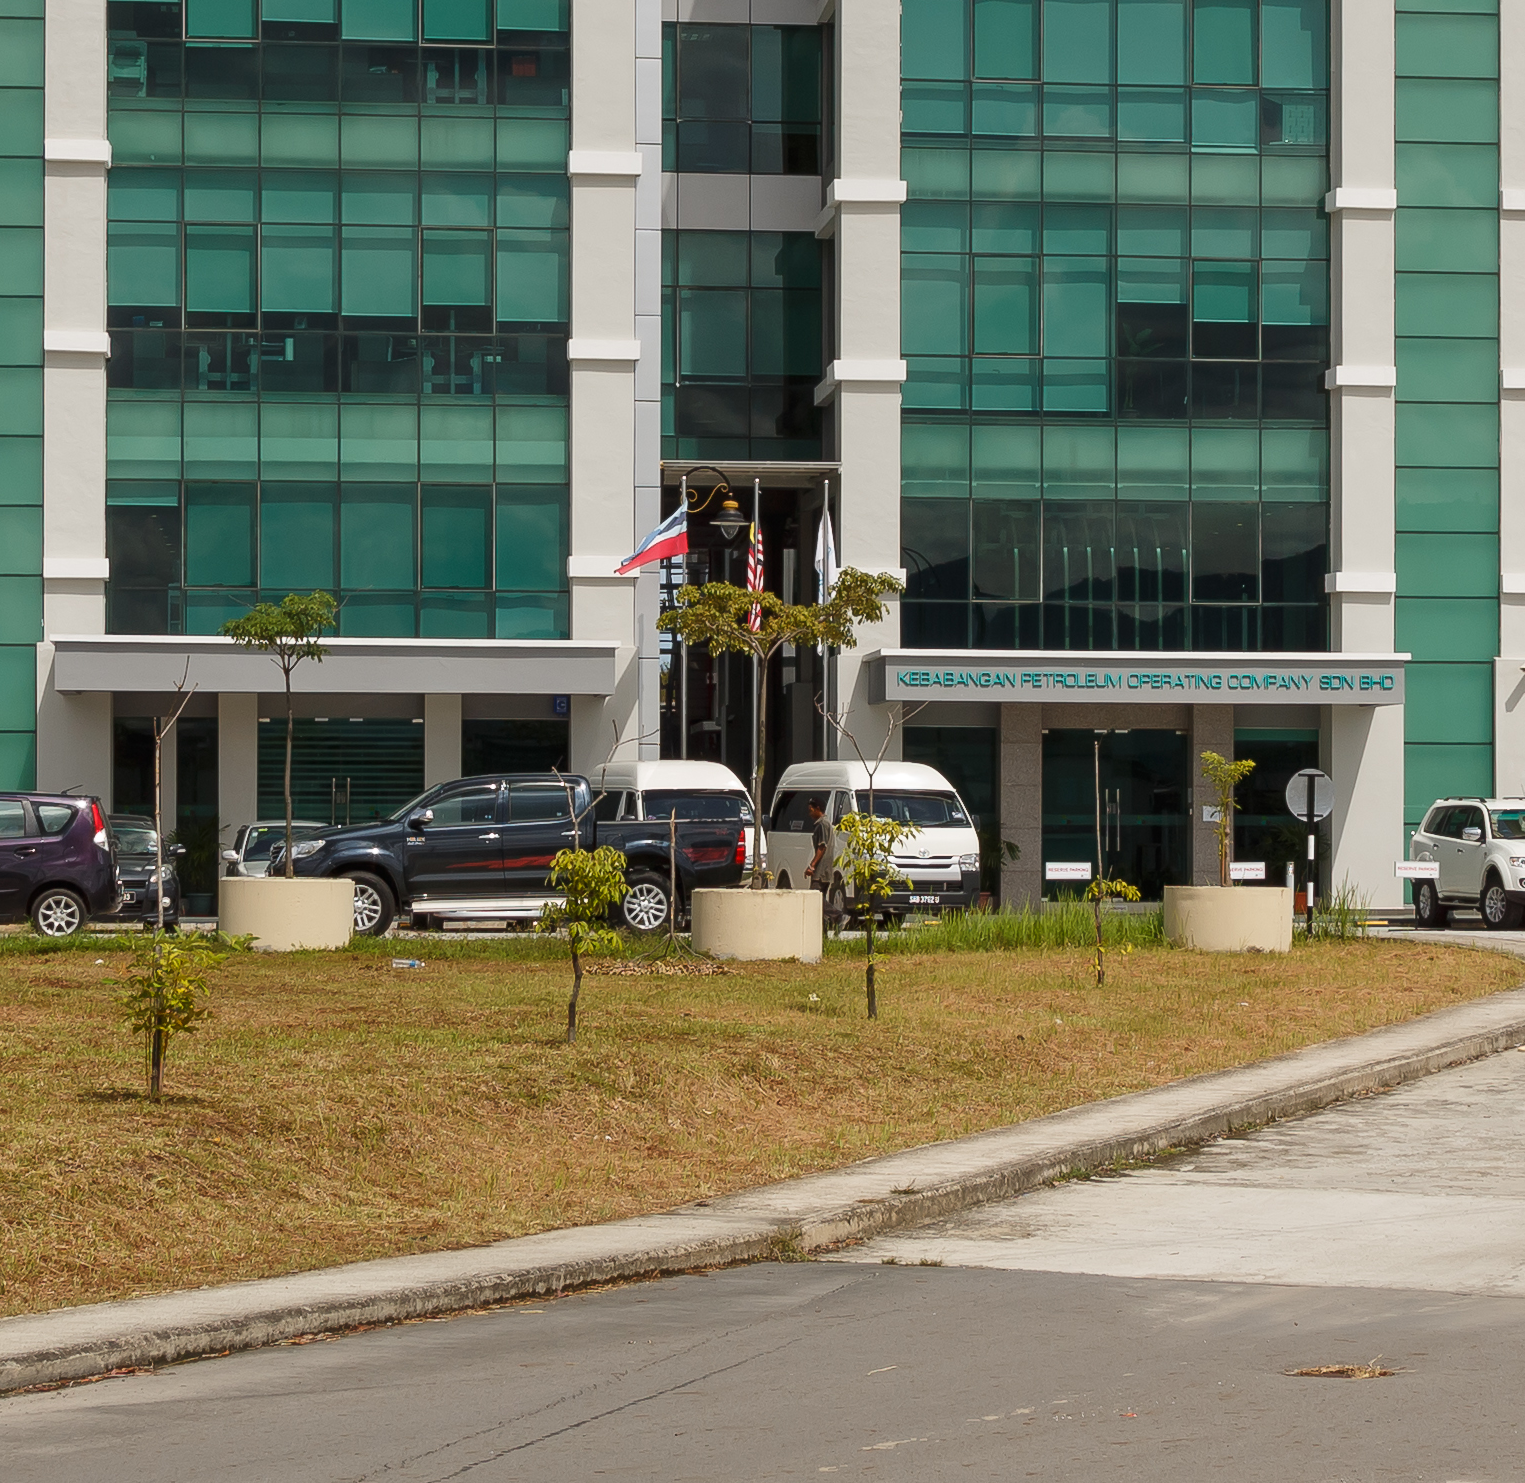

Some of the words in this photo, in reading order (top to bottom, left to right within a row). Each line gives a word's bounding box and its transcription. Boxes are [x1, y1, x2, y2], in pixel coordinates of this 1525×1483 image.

[897, 671, 1016, 687] KEBABANGAN
[1021, 672, 1122, 688] PETROLEUM
[1127, 672, 1222, 689] OPERATING
[1228, 673, 1314, 690] COMPANY
[1319, 673, 1355, 690] SDN
[1359, 674, 1395, 690] BHD
